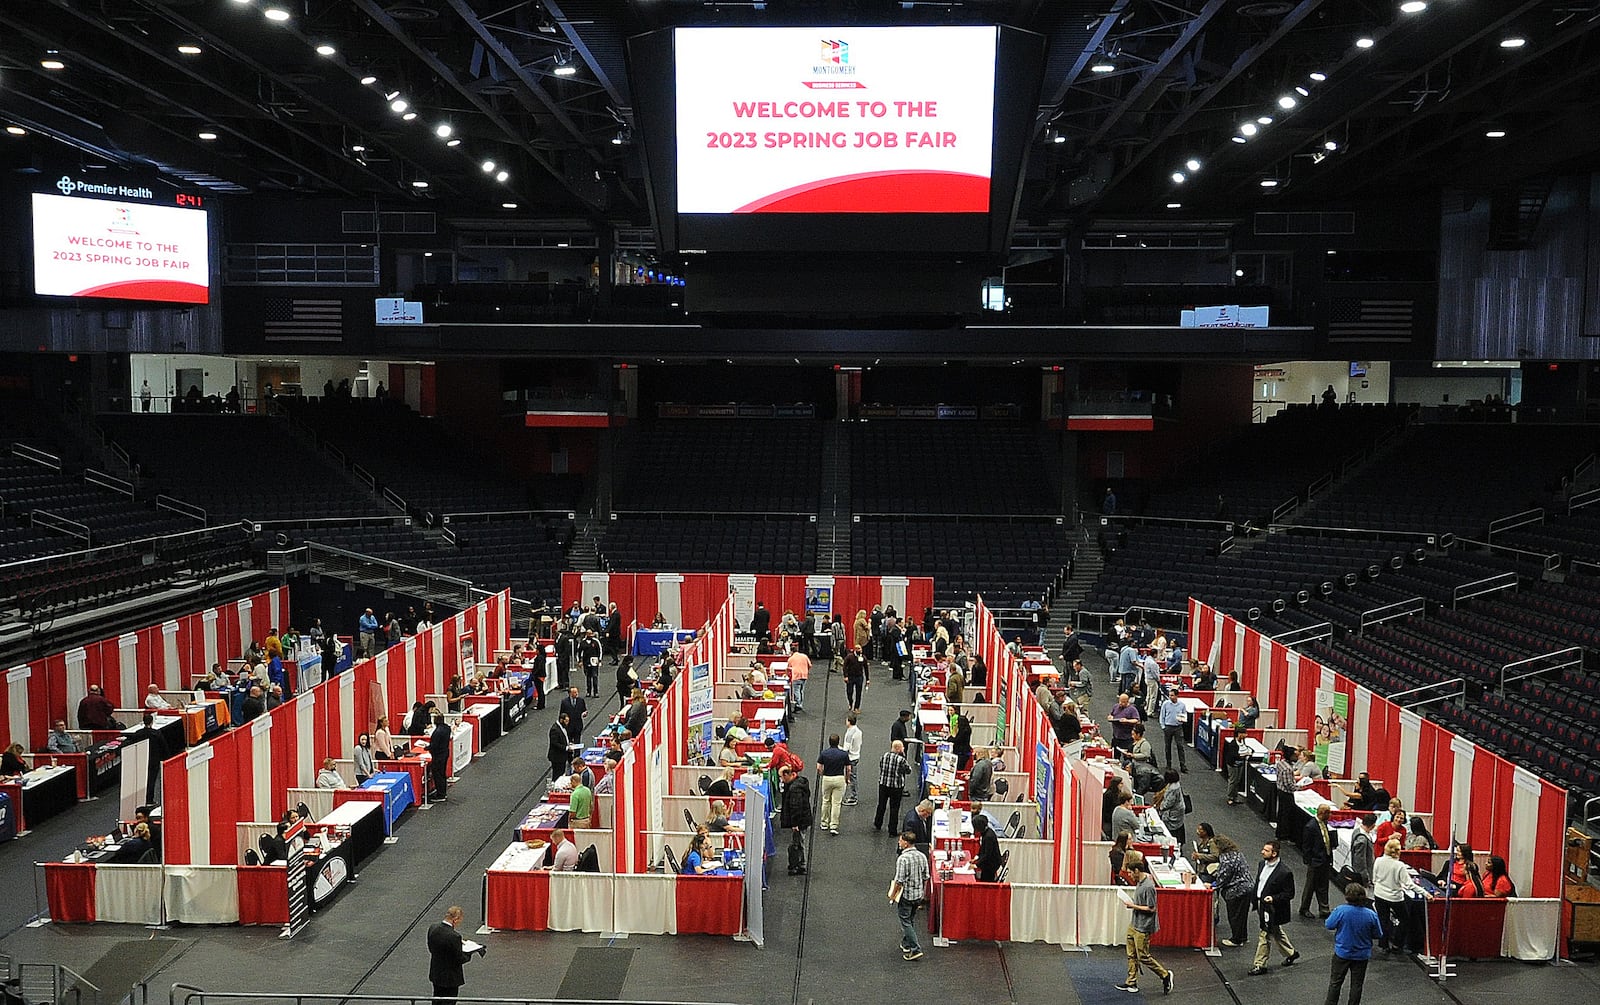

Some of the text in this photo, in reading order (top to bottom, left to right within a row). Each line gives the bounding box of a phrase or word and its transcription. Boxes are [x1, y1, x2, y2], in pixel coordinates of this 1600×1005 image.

[812, 65, 857, 75] MONTGOMERY
[732, 101, 937, 118] WELCOME TO THE
[706, 131, 958, 148] 2023 SPRING JOB FAIR
[77, 181, 153, 199] Premier Health
[67, 235, 179, 253] WELCOME TO THE
[53, 250, 190, 270] 2023 SPRING JOB FAIR
